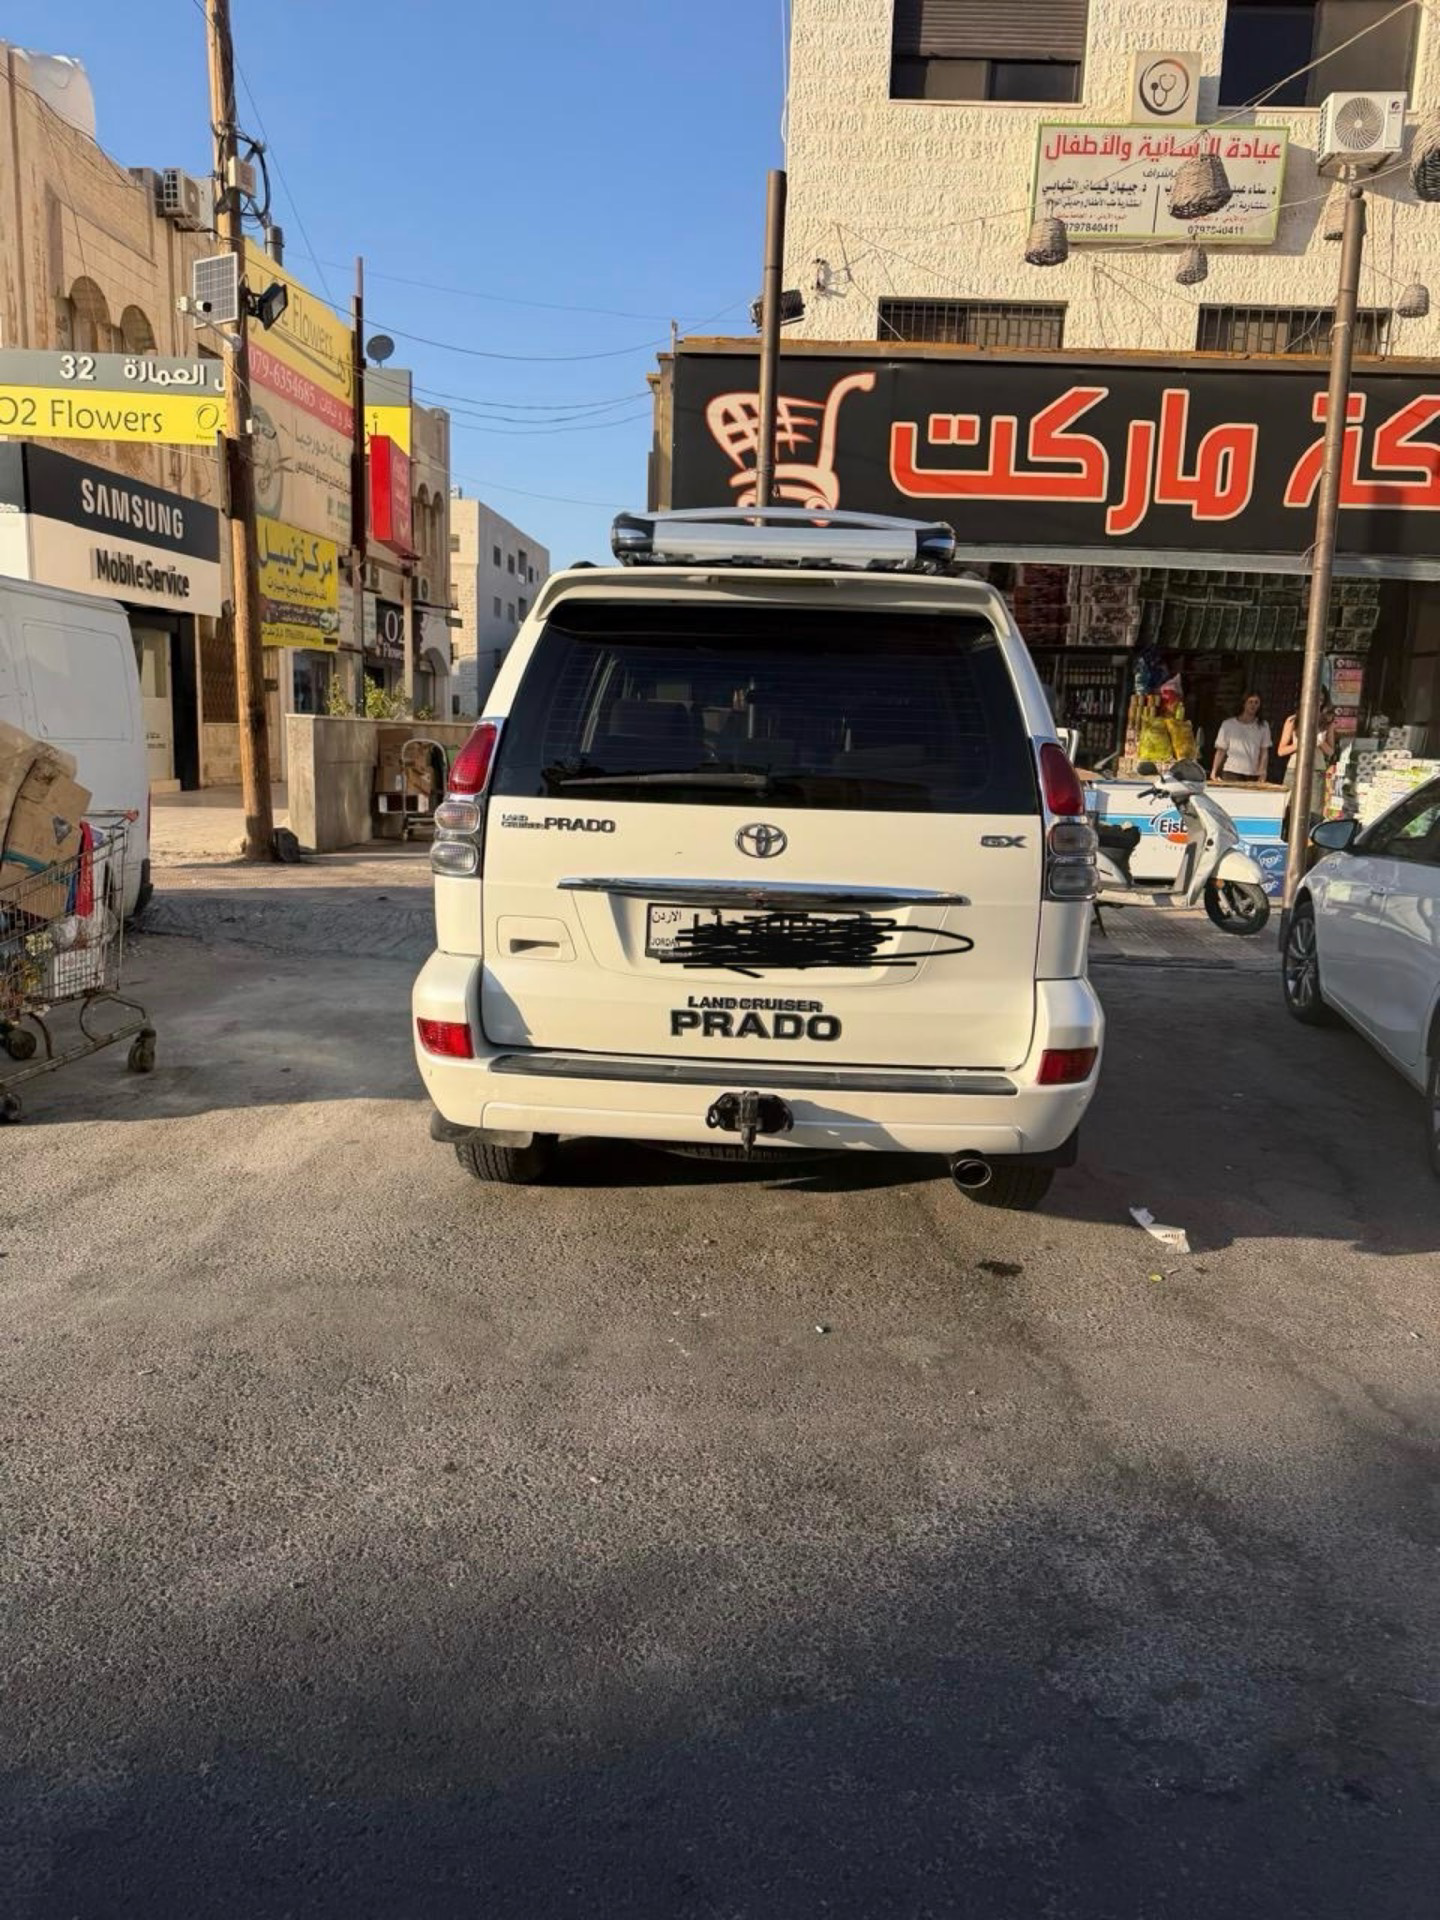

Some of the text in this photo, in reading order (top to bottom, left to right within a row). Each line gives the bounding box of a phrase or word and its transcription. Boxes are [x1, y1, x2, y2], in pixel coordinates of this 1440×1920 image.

[1226, 137, 1281, 164] عيادة
[59, 354, 97, 381] 32
[123, 358, 207, 386] العمارة
[50, 399, 163, 434] Flowers
[888, 386, 1260, 536] ماركت
[81, 478, 184, 540] SAMSUNG
[95, 547, 190, 598] Mobile Service
[544, 816, 616, 834] PRADO
[651, 936, 681, 948] JORDAN
[687, 995, 824, 1013] LAND CRUISER
[670, 1008, 843, 1042] PRADO
